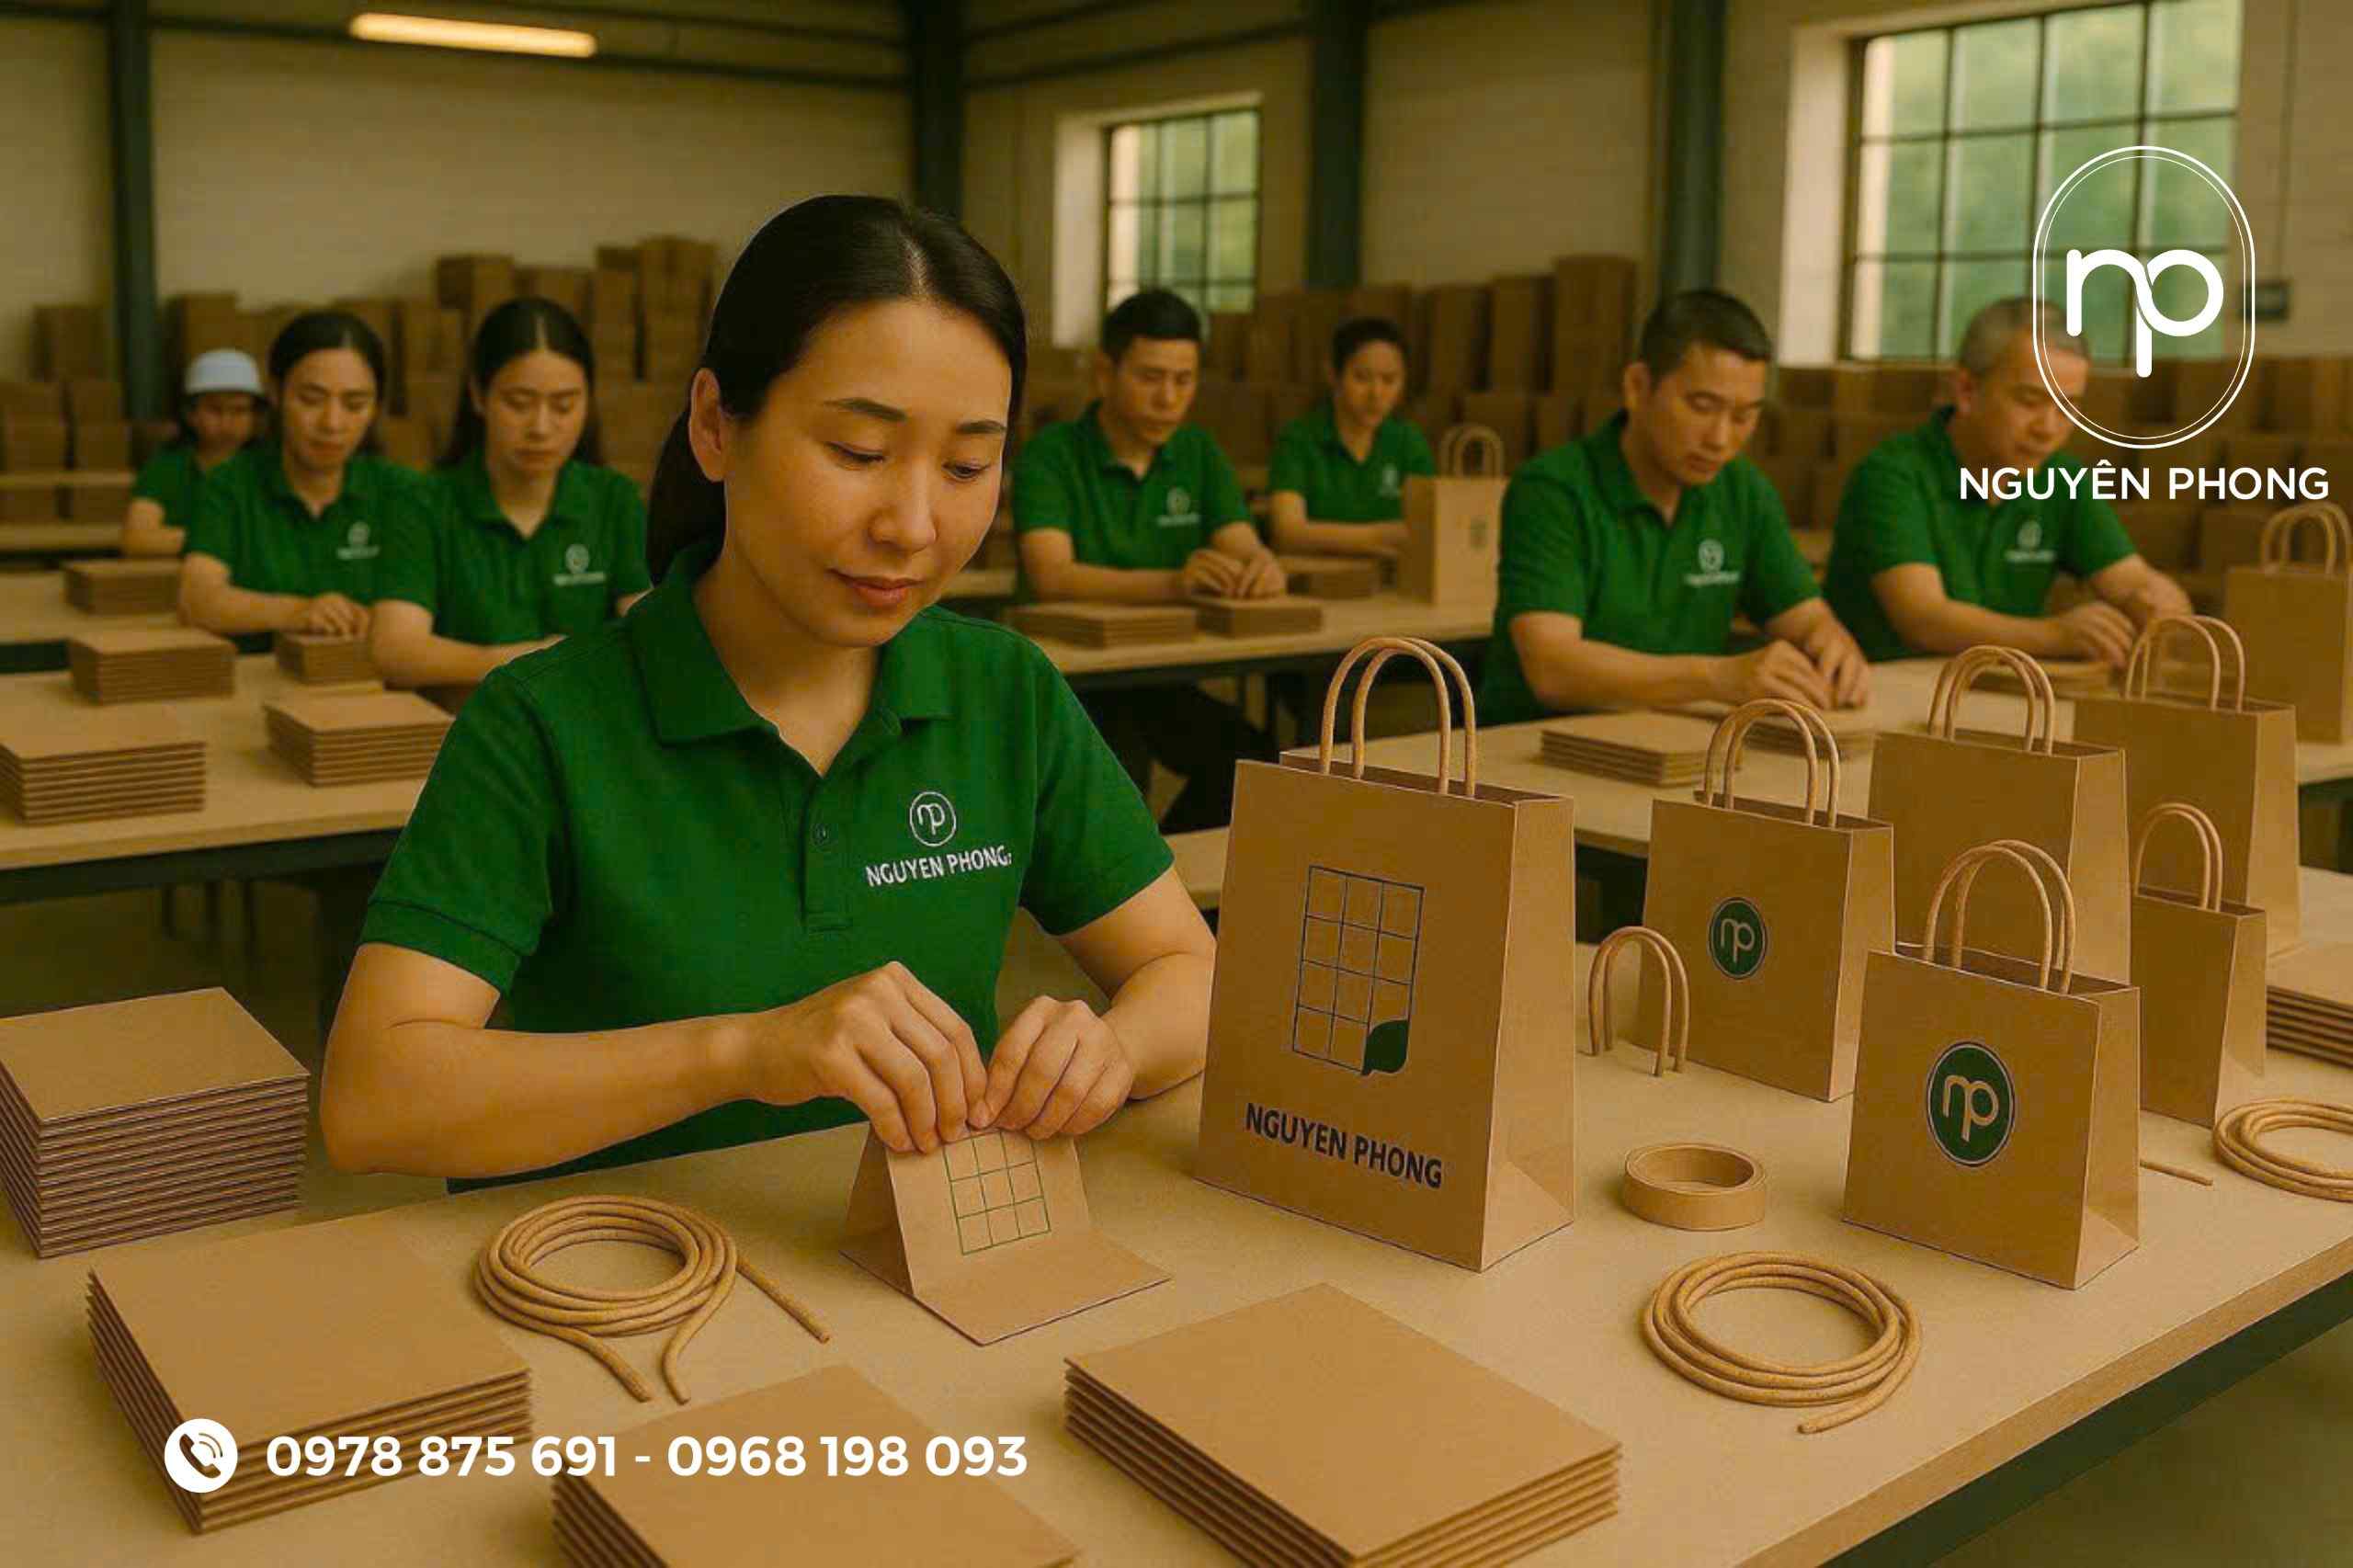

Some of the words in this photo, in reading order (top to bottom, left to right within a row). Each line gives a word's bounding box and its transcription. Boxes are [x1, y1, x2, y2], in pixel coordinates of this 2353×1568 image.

[865, 856, 944, 887] NGUYEN
[1245, 1102, 1347, 1160] NGUYEN
[1353, 1135, 1442, 1189] PHONG
